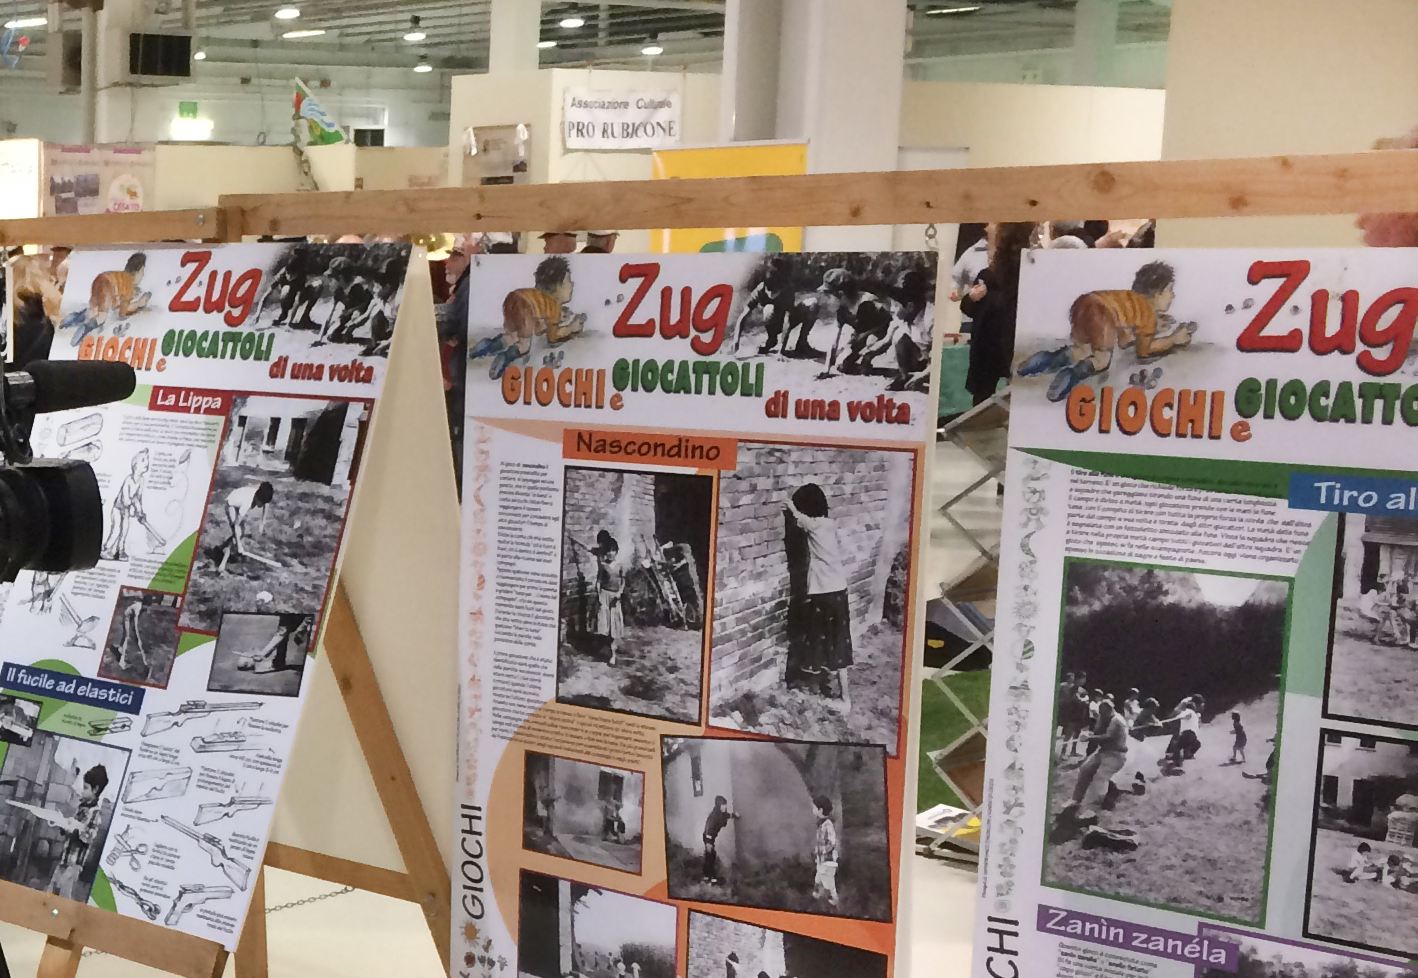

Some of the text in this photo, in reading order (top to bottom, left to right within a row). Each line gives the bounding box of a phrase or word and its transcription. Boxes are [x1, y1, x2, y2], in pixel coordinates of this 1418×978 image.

[568, 120, 677, 139] PRO RUBICONE
[168, 250, 263, 328] Zug
[612, 262, 734, 357] Zug
[1236, 260, 1418, 377] Zug
[77, 335, 158, 373] GIOCHI
[161, 329, 276, 362] GIOCATTOLI
[268, 355, 375, 385] di una volta
[156, 388, 222, 415] La Lippa
[501, 358, 765, 411] GIOCHI e GIOCATTOLI
[764, 390, 912, 425] di una volta
[1066, 377, 1418, 443] GIOCHI e GIOCATTO
[576, 431, 722, 462] Nascondino
[1313, 481, 1418, 511] Tiro al
[5, 666, 134, 707] Il fucile ad elastici
[460, 803, 484, 921] GIOCHI
[1046, 908, 1227, 965] Zanìn zanéla
